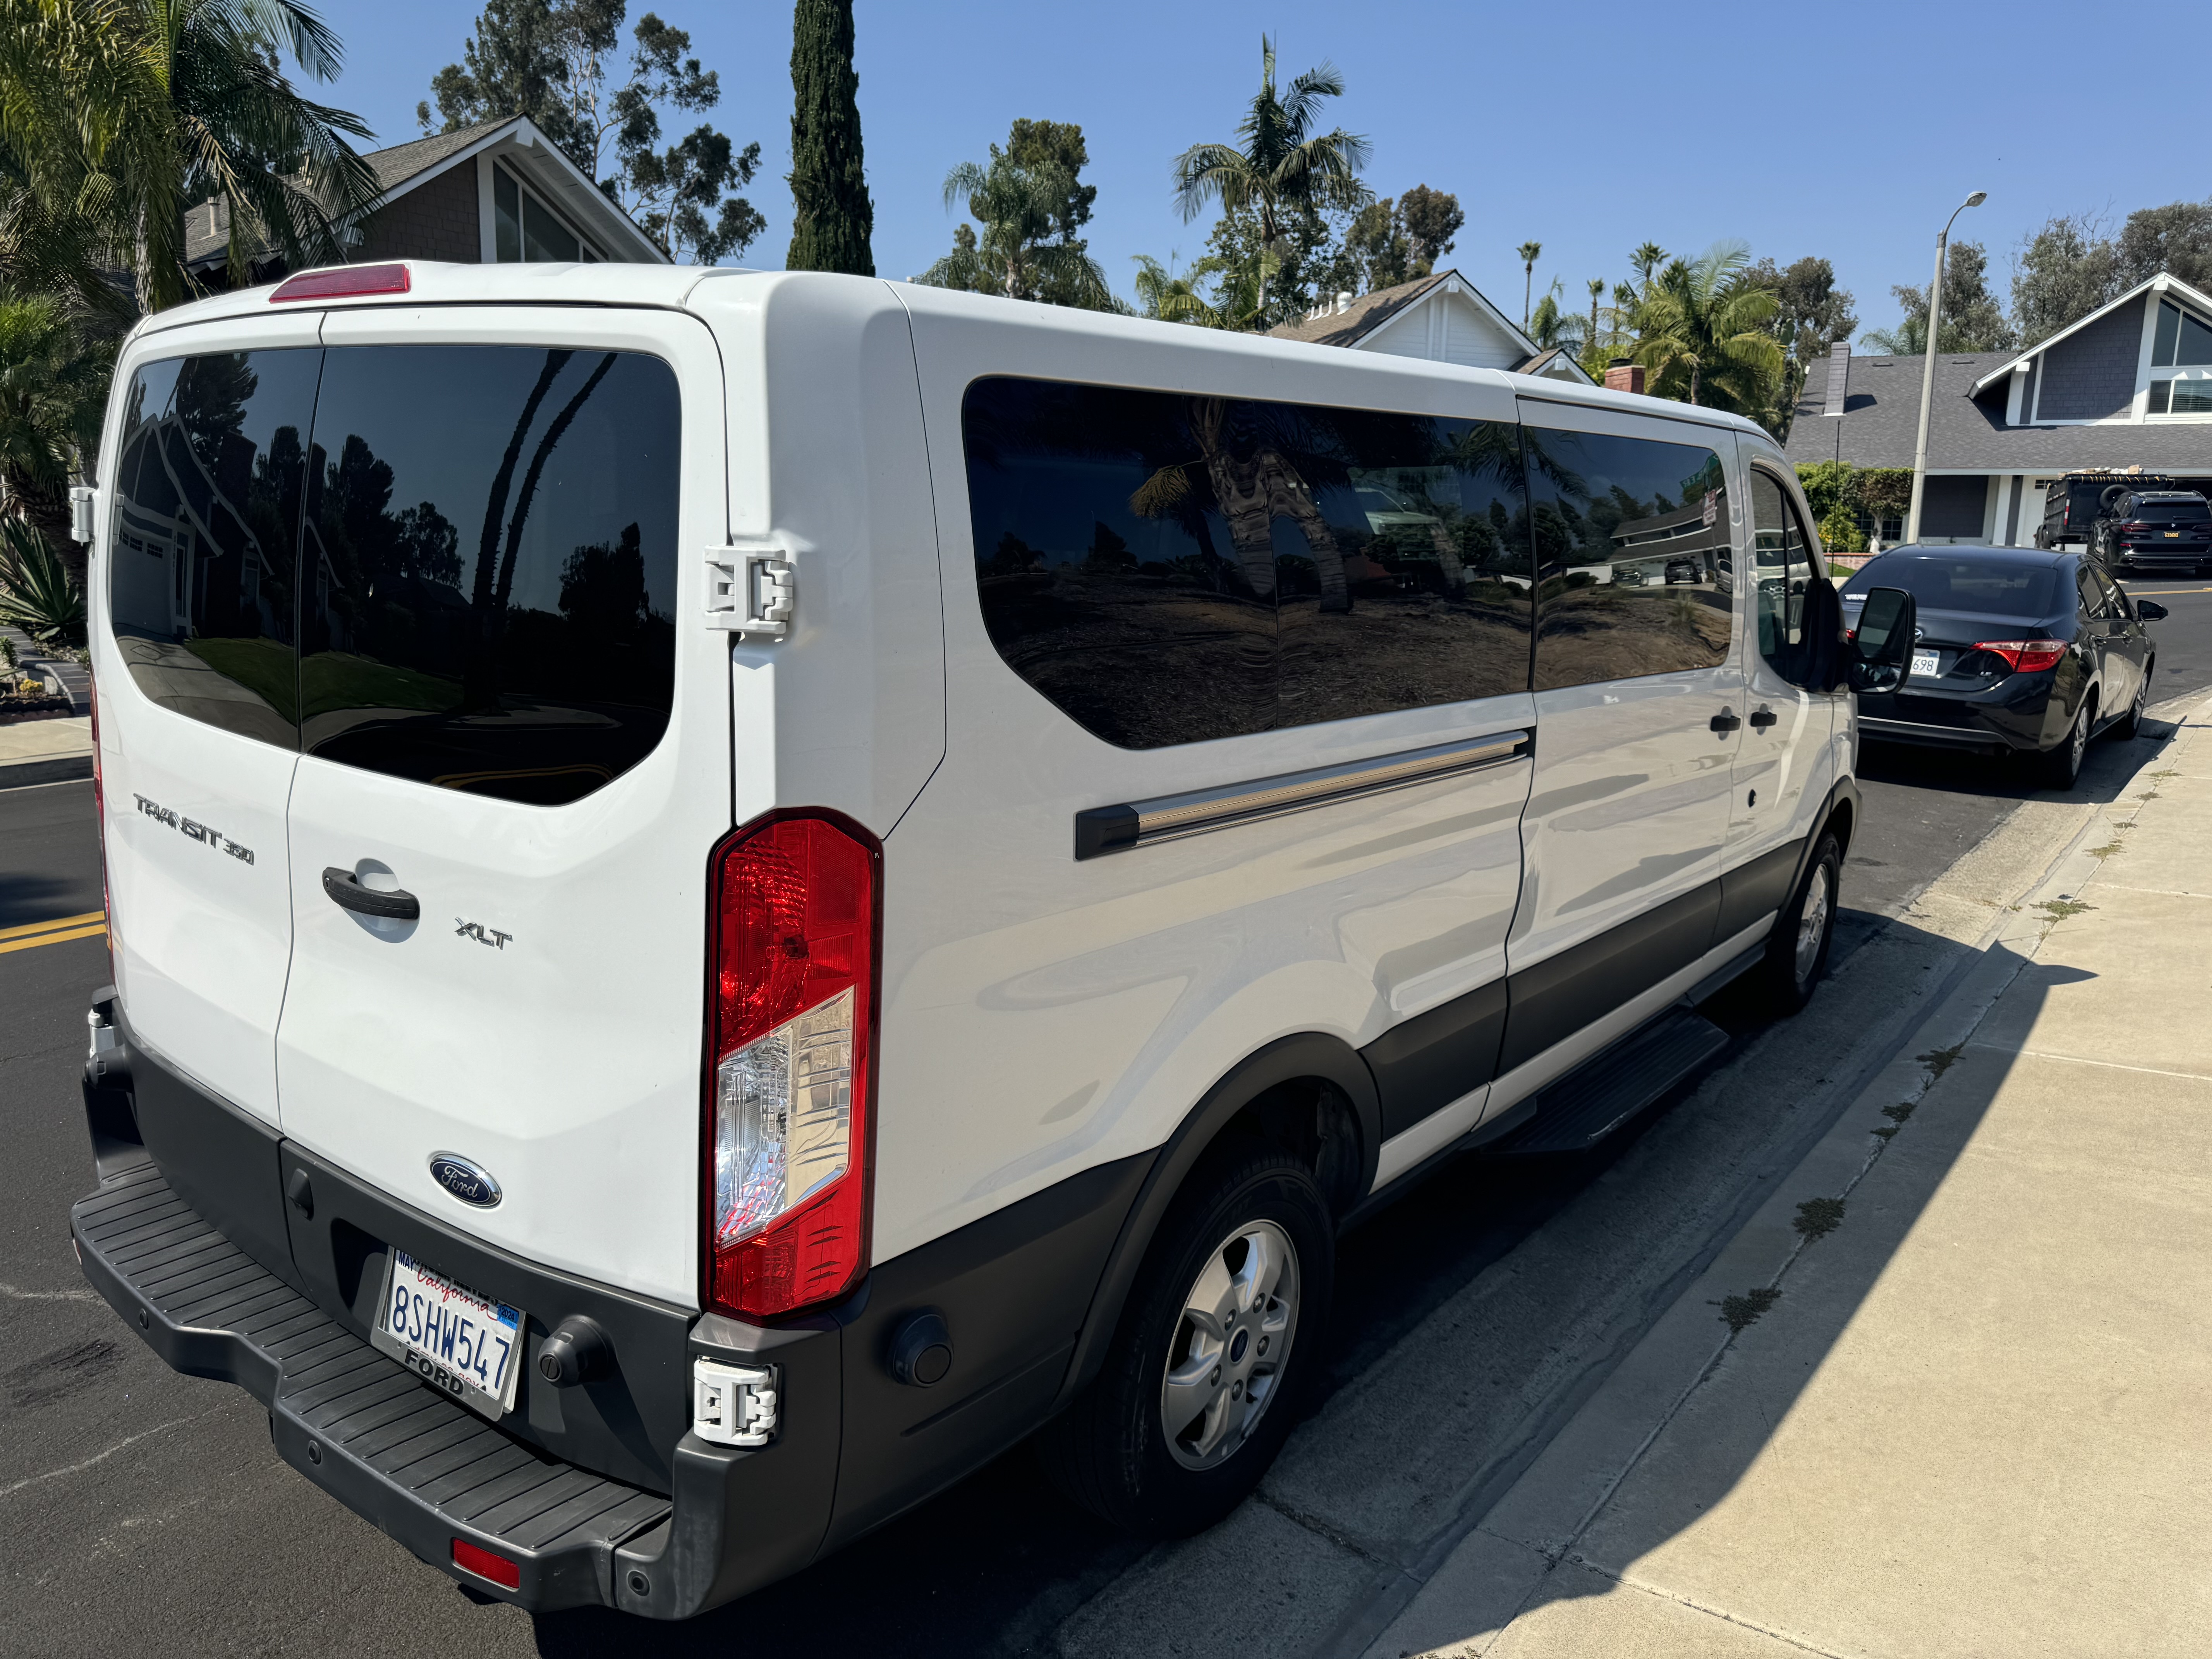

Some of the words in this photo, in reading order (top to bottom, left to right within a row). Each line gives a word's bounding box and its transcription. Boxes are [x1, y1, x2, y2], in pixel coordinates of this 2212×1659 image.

[1913, 659, 1934, 672] 698
[133, 793, 223, 849] TRANSIT
[223, 838, 254, 866] 350
[454, 917, 513, 950] XLT
[441, 1166, 478, 1198] Ford
[399, 1251, 416, 1271] MAY
[417, 1267, 498, 1321] California
[501, 1307, 515, 1321] 2024
[393, 1285, 510, 1389] 8SHW547
[405, 1348, 464, 1395] FORD
